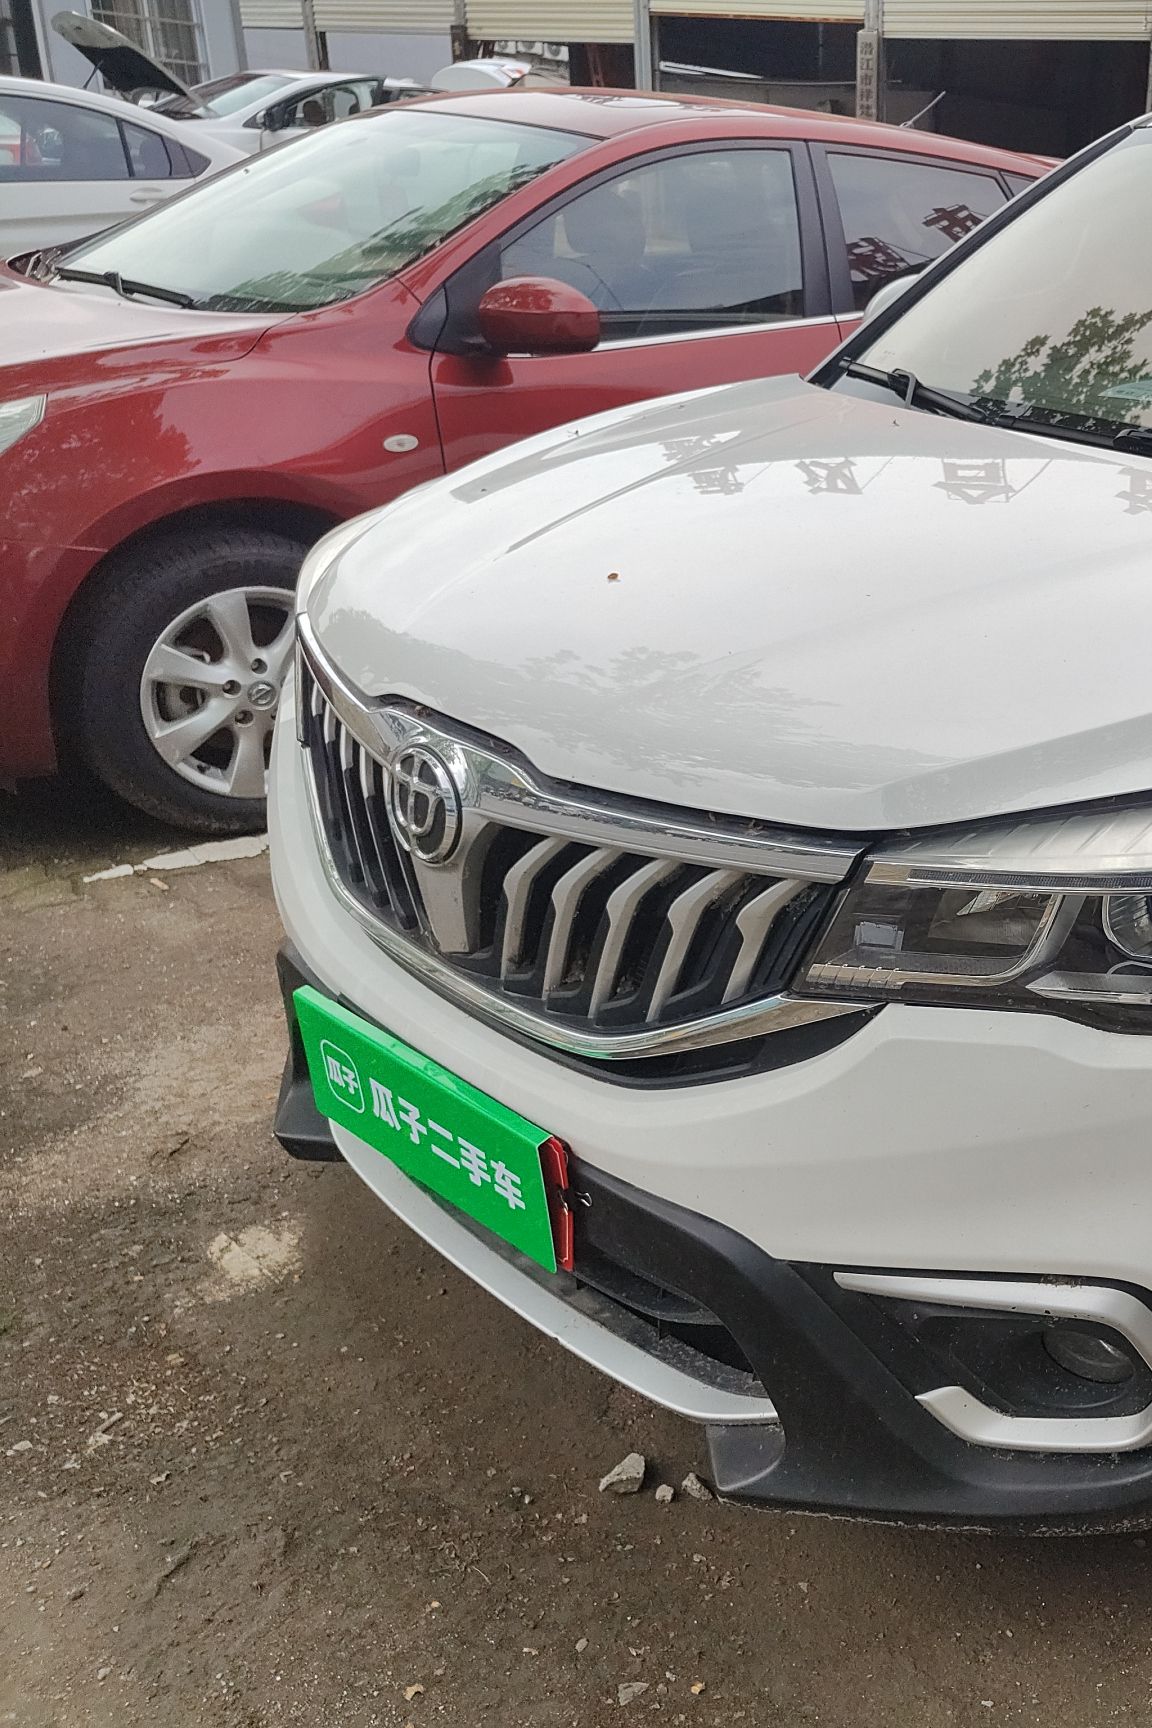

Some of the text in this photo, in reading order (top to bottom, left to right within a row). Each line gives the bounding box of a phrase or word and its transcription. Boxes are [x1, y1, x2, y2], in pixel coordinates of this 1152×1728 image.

[325, 1055, 359, 1095] 瓜子
[369, 1077, 526, 1211] 瓜子二手车
